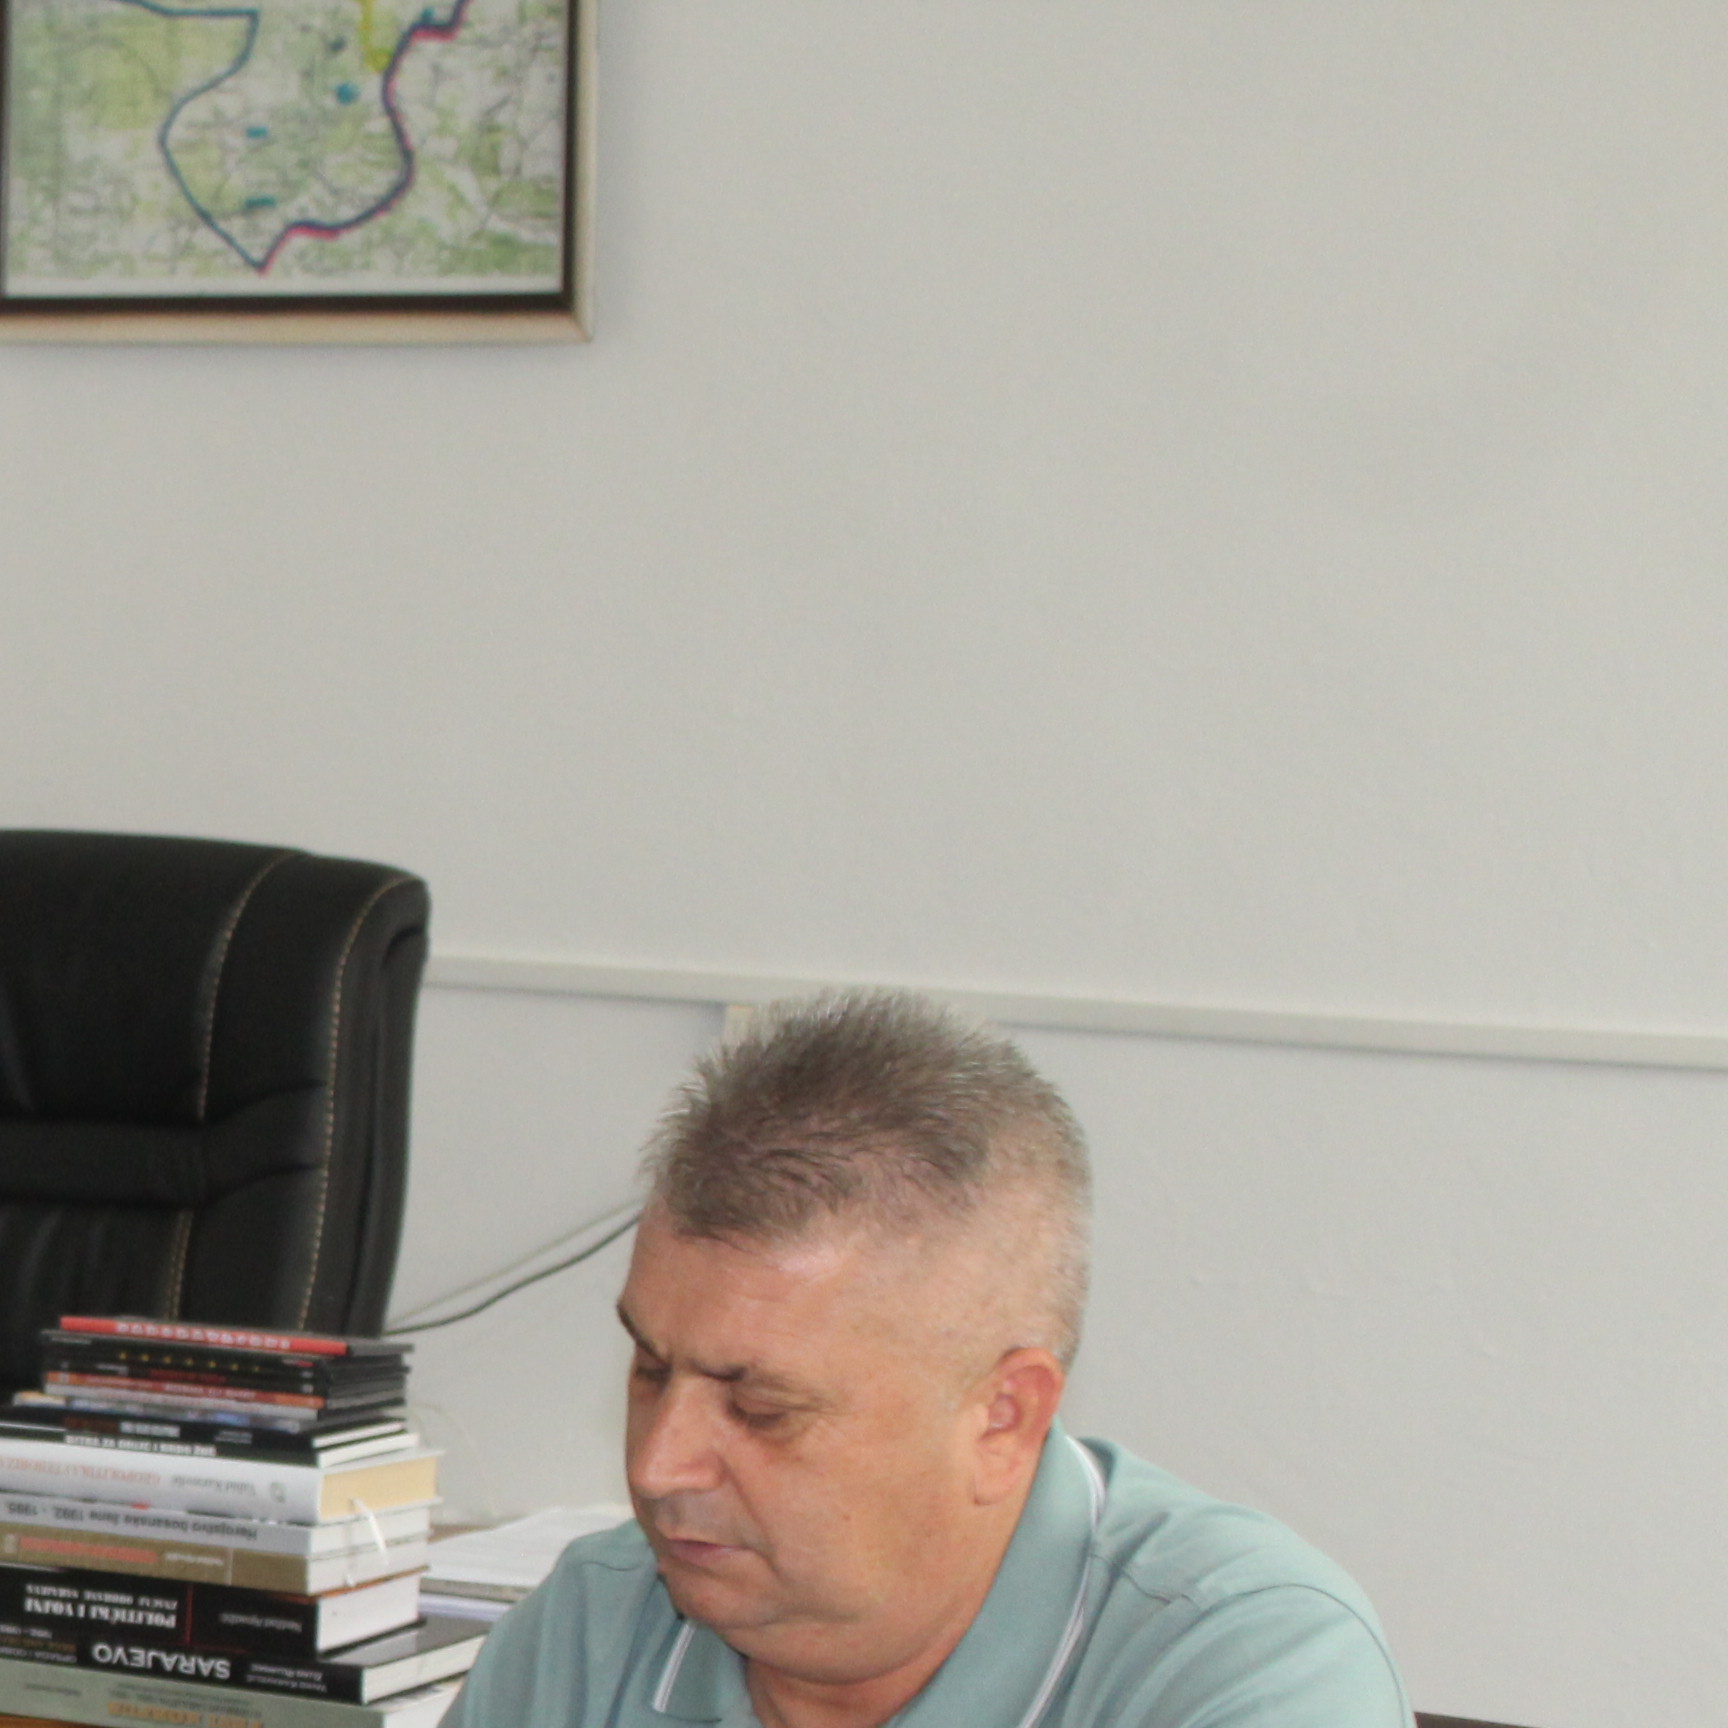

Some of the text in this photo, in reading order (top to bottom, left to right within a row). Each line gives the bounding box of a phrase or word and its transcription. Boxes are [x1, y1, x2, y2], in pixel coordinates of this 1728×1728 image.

[88, 1511, 120, 1526] žene
[124, 1514, 188, 1533] bosanske
[192, 1522, 258, 1540] Herojstvo
[92, 1642, 231, 1680] SARAJEVO
